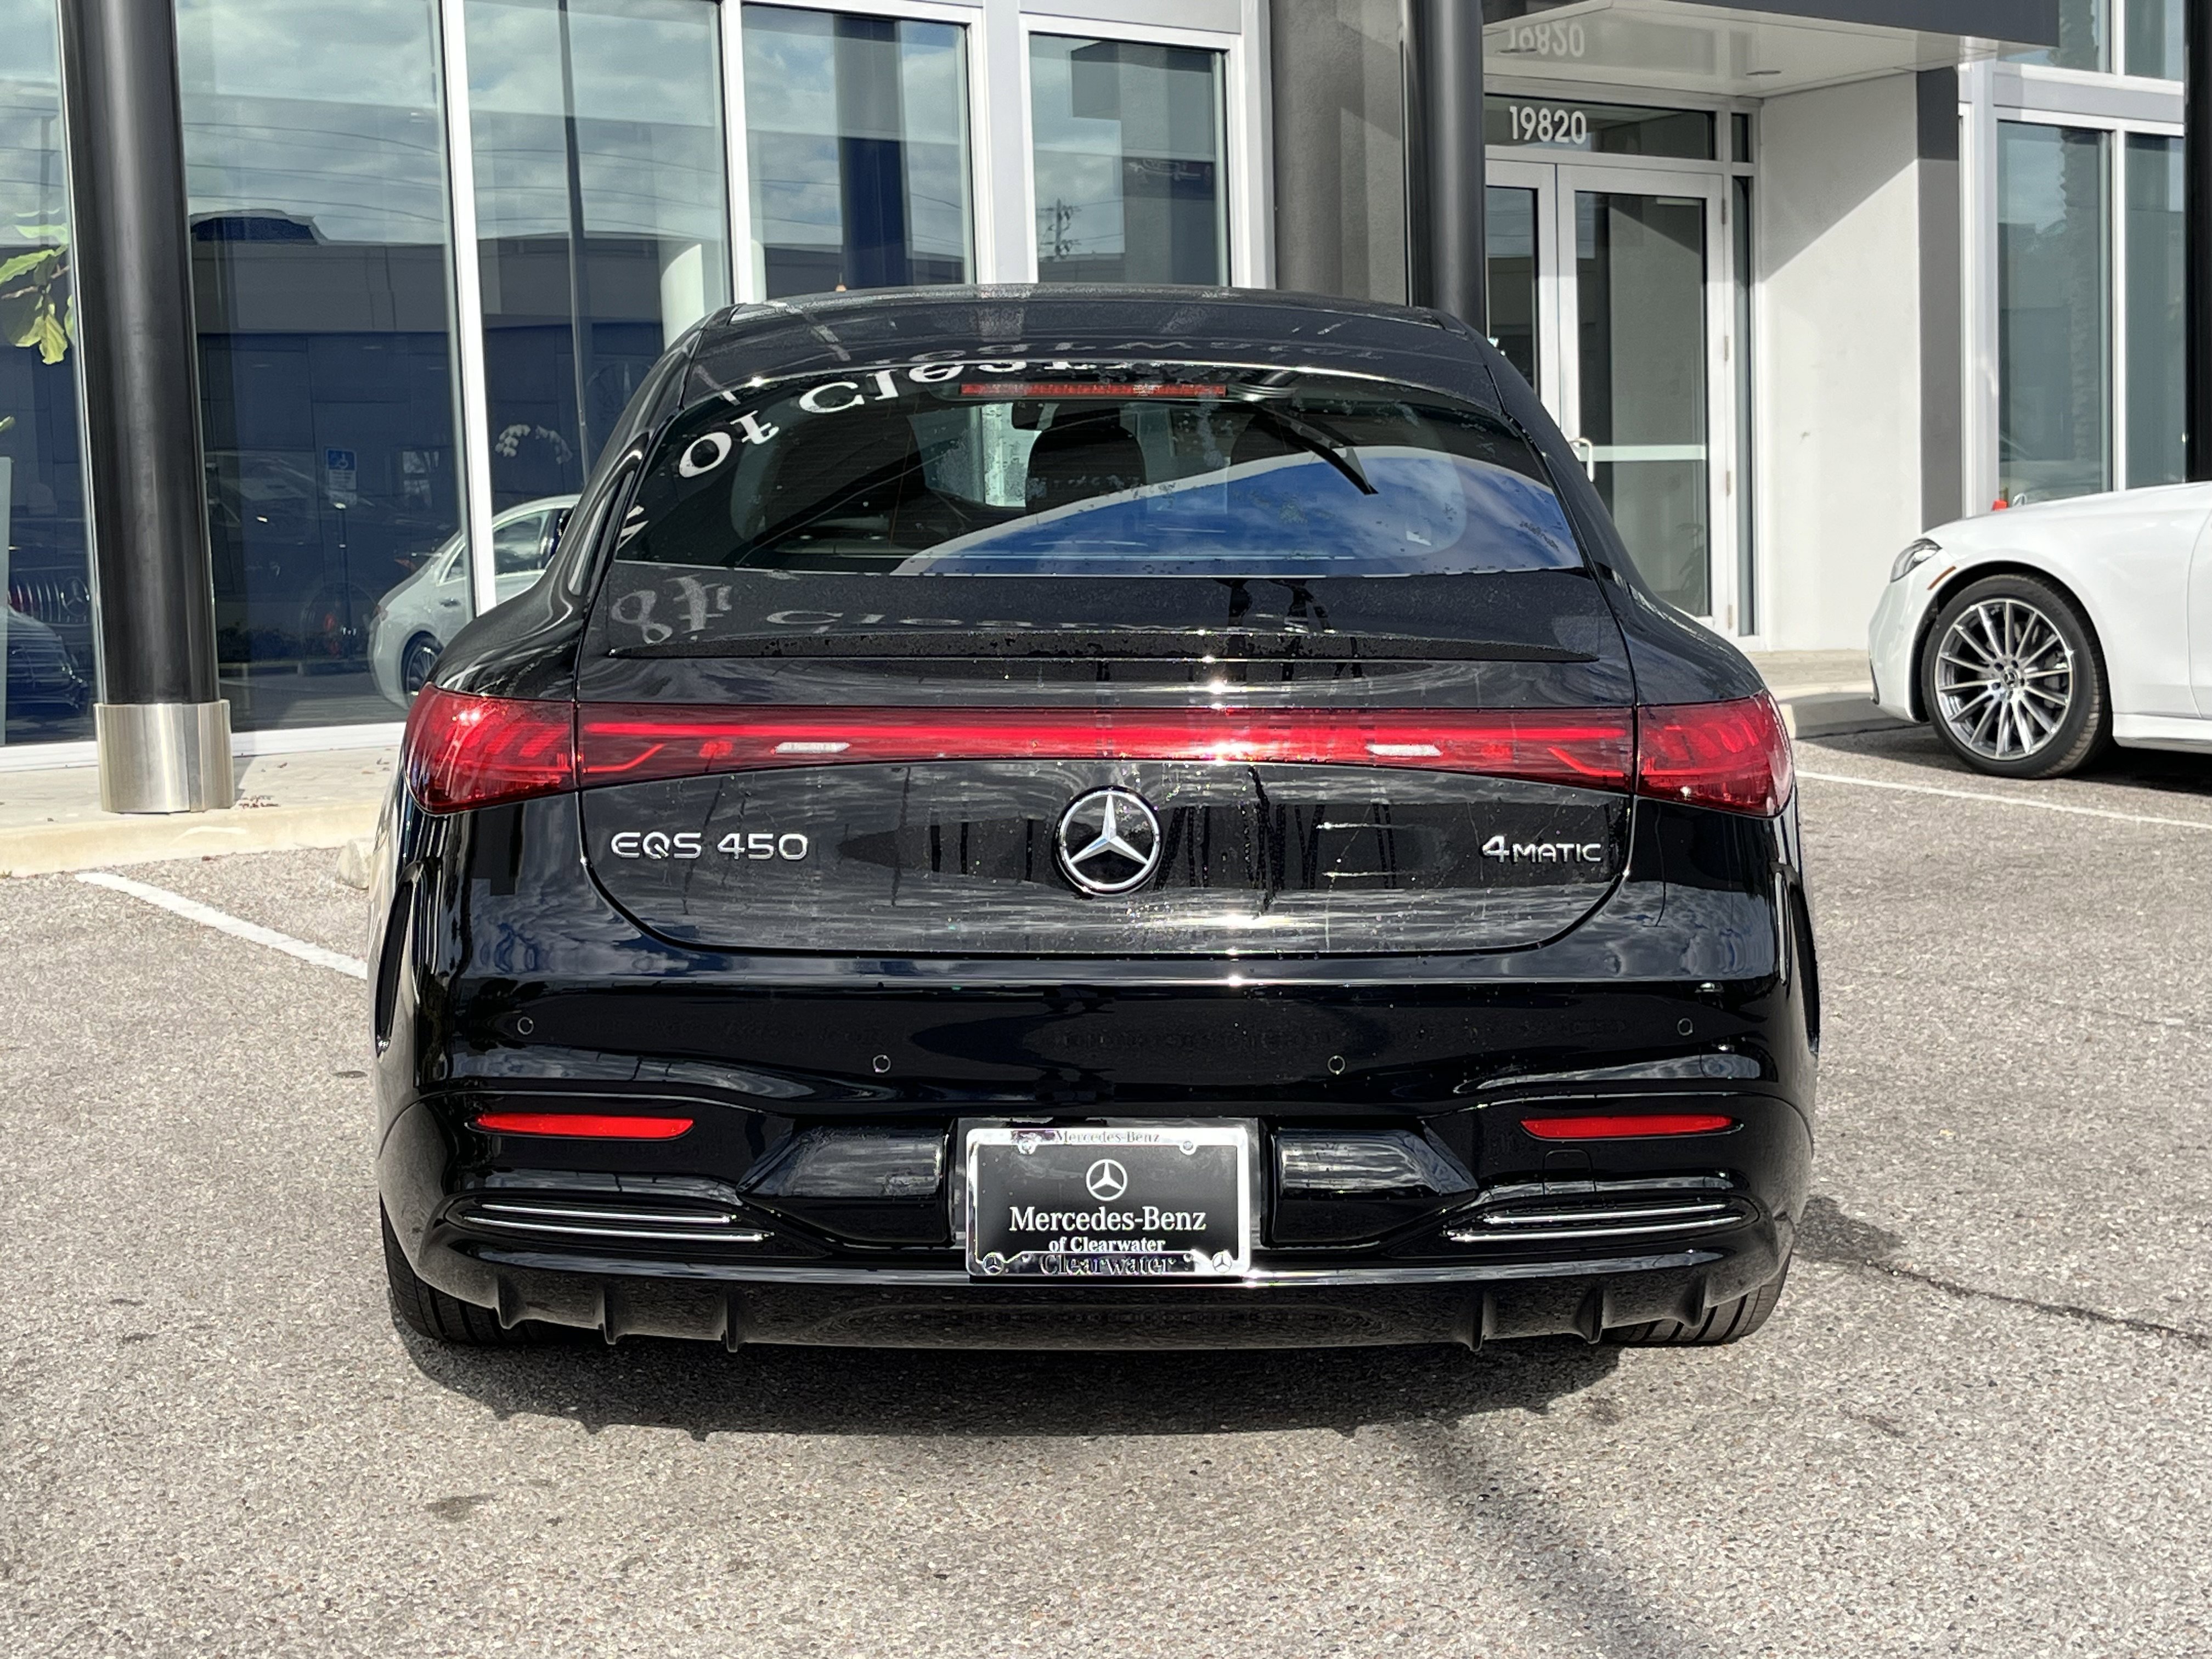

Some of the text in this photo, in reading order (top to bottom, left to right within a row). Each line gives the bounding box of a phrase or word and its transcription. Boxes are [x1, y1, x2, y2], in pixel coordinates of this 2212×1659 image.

[1509, 106, 1587, 144] 19820
[611, 831, 808, 860] EQS 450
[1482, 835, 1601, 863] 4MATIC
[1054, 1130, 1159, 1144] Mercedes-Benz
[1009, 1206, 1206, 1231] Mercedes-Benz
[1048, 1236, 1166, 1251] of Clearwater
[1040, 1254, 1172, 1275] Clearwater
